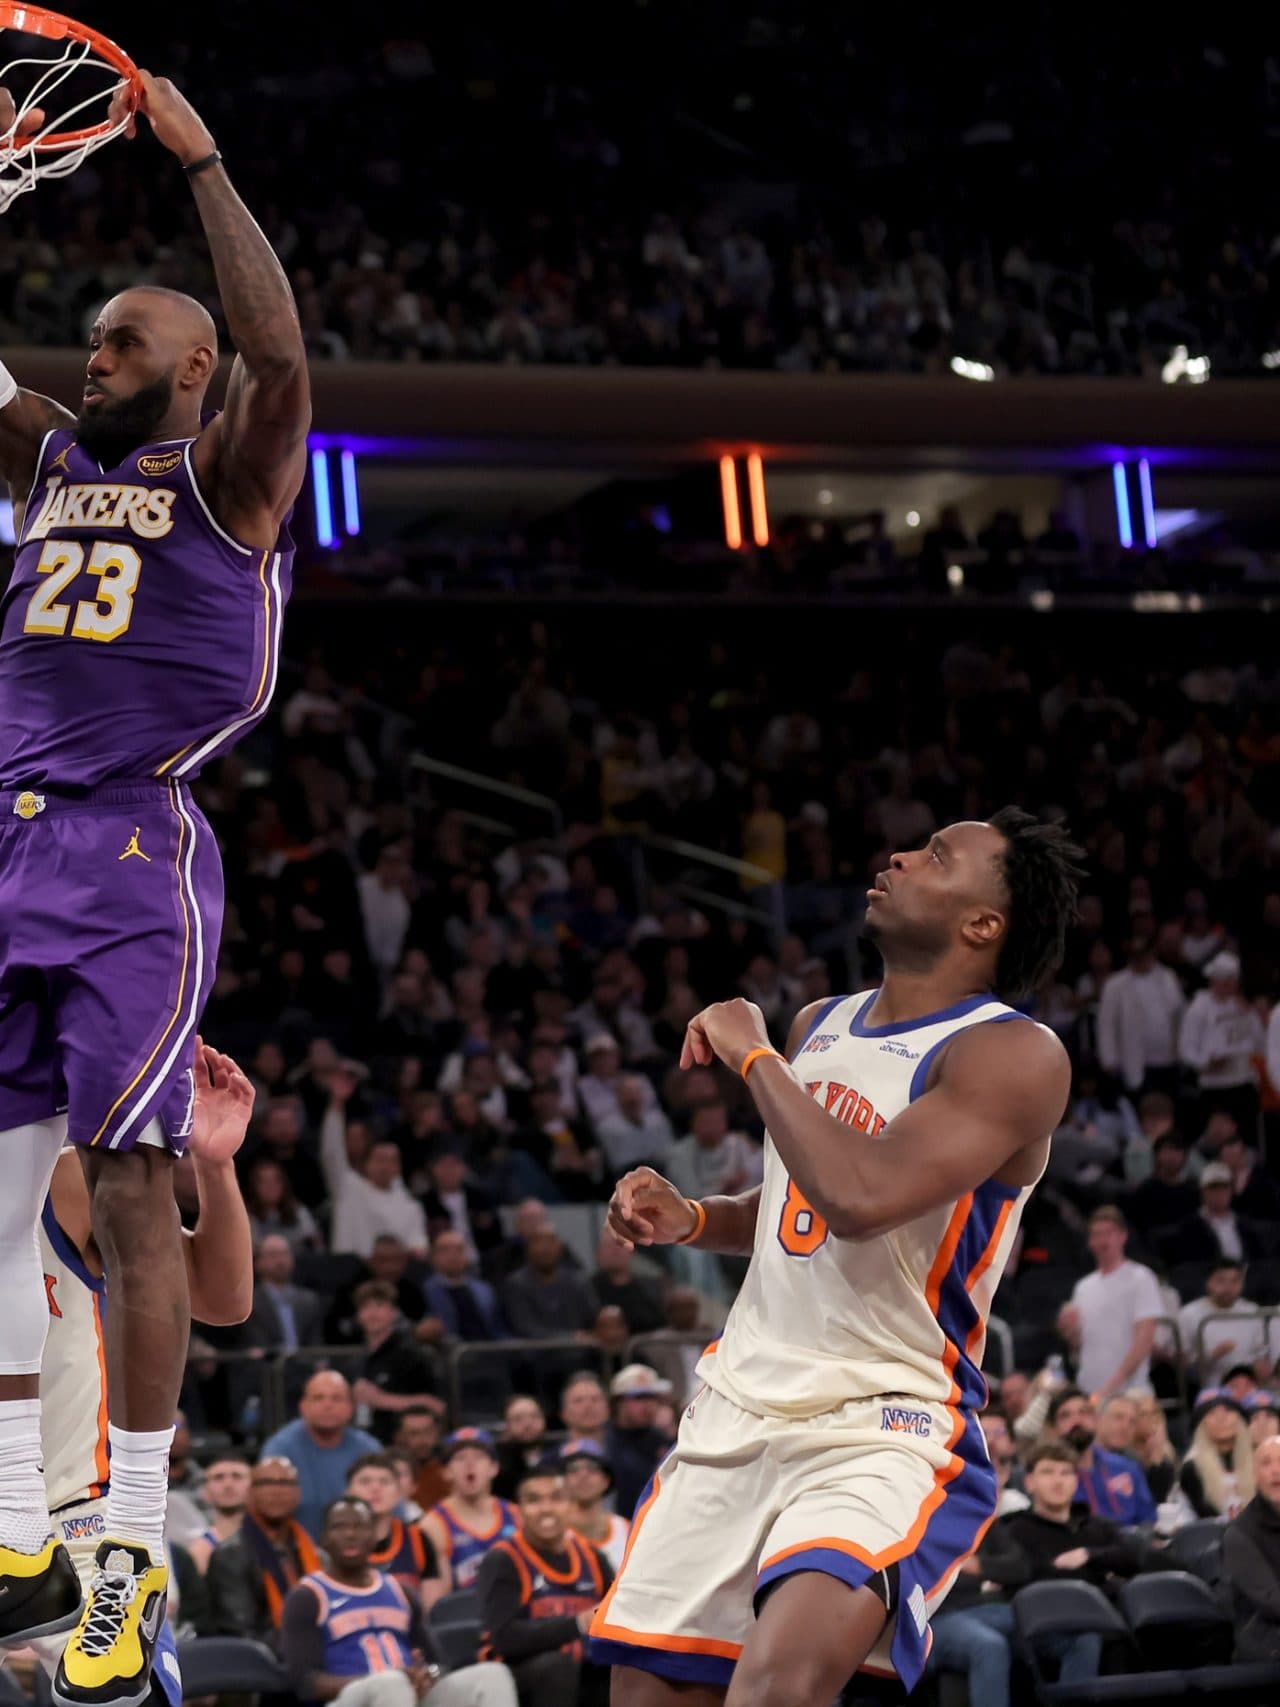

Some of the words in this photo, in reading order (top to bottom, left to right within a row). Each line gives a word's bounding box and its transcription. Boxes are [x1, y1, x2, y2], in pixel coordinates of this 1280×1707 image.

[24, 475, 177, 540] LAKERS
[23, 539, 142, 643] 23
[881, 1407, 932, 1437] NYC
[61, 1514, 106, 1540] NYC
